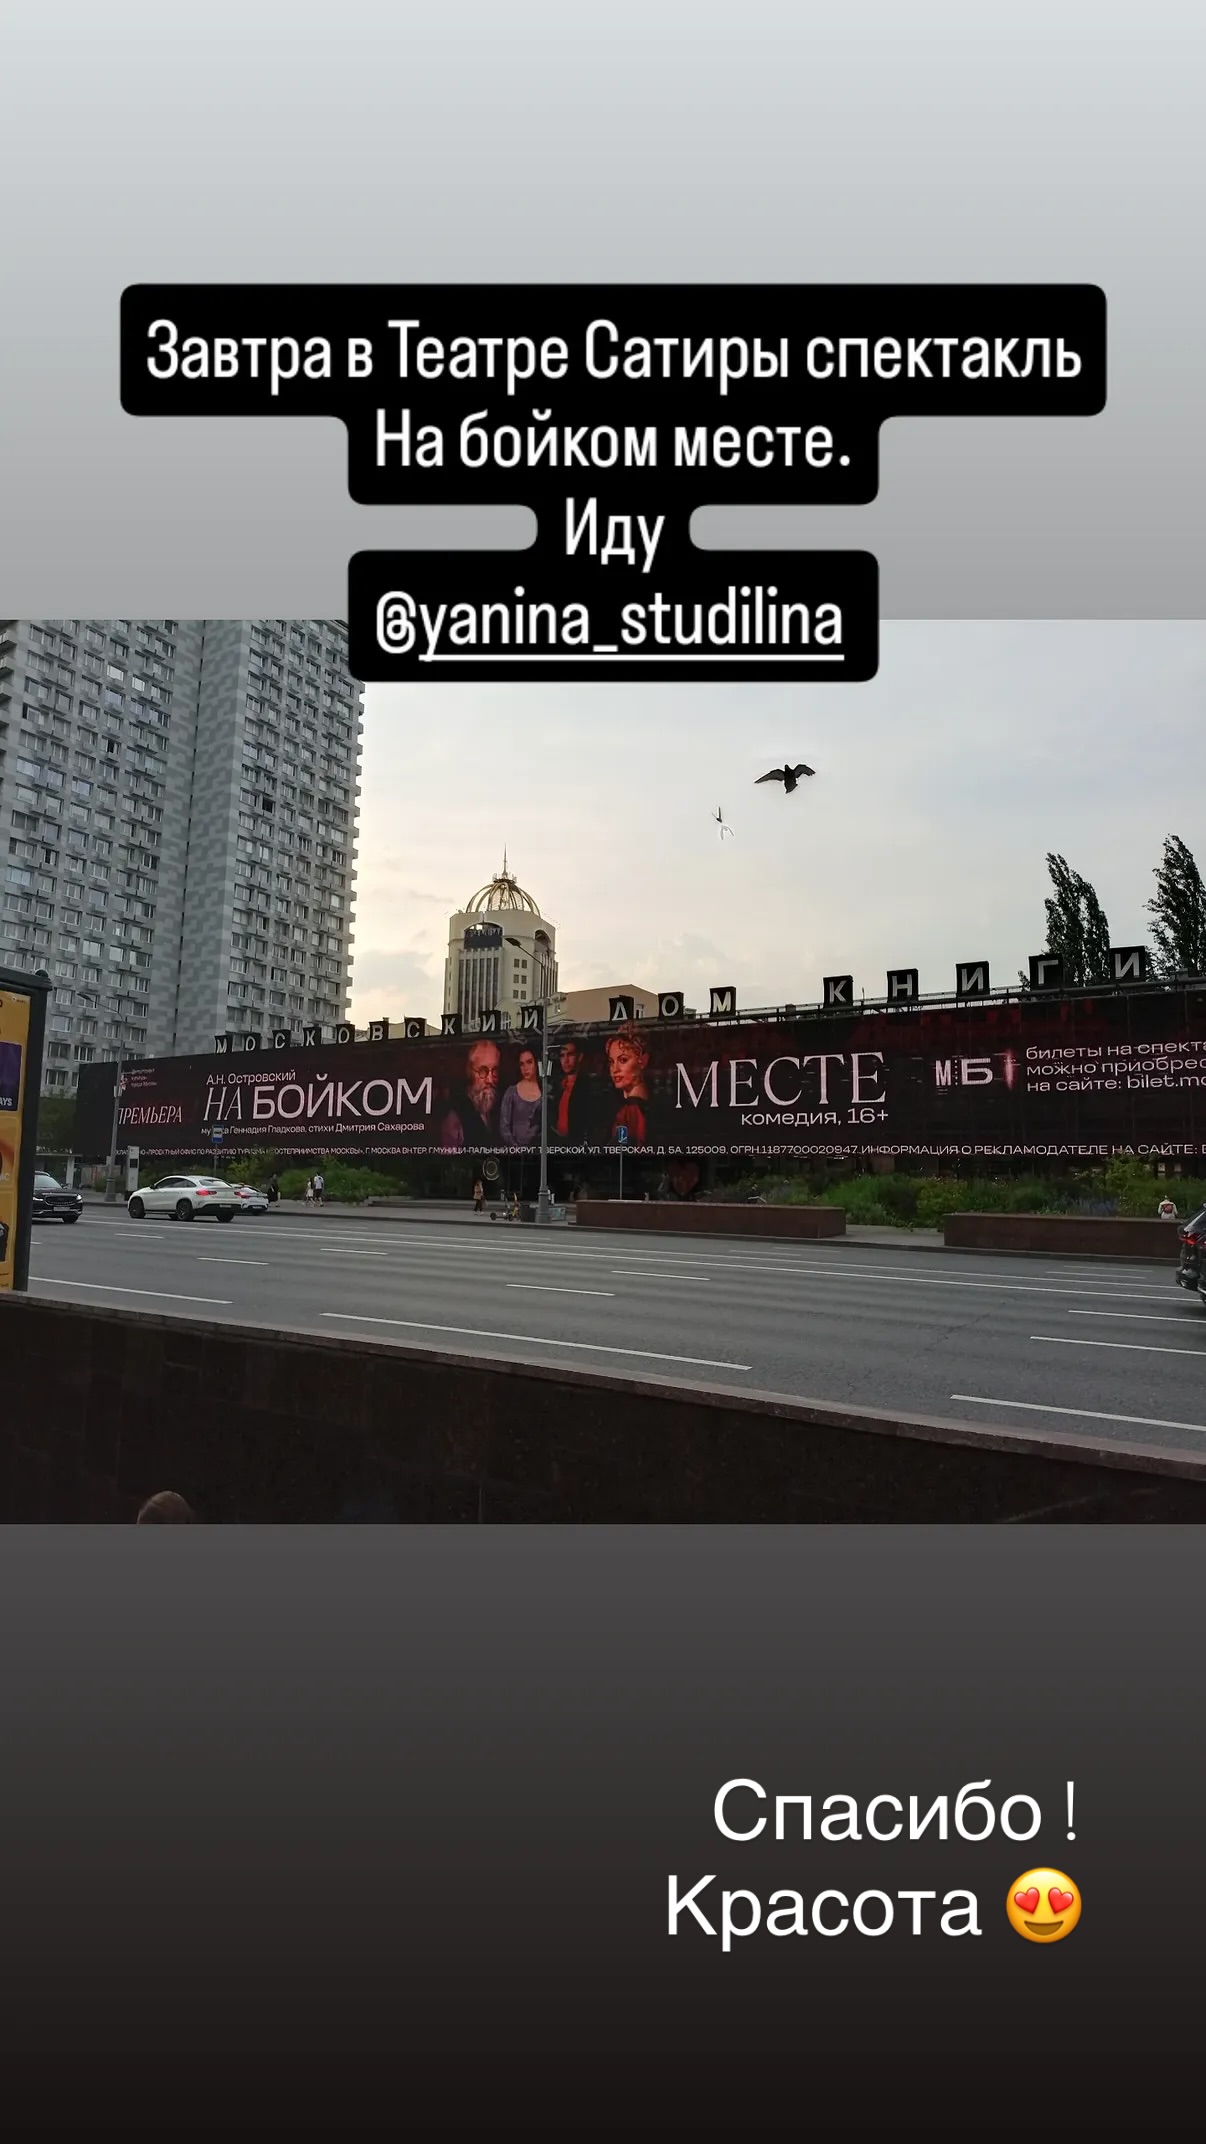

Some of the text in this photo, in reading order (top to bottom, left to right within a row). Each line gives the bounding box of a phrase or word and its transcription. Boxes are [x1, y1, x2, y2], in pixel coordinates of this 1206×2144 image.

[215, 952, 1140, 1054] МОСКОВСКИЙ ДОМ КНИГИ
[1025, 1041, 1206, 1060] билеты на спект
[206, 1069, 296, 1086] А.Н. Островский
[1026, 1062, 1097, 1077] можно
[675, 1051, 886, 1109] МЕСТЕ
[1027, 1080, 1050, 1092] на
[1055, 1076, 1122, 1092] сайте:
[203, 1073, 433, 1121] НА БОЙКОМ
[740, 1107, 889, 1127] комедия, 16+
[308, 1125, 334, 1133] стихи
[335, 1123, 376, 1134] Дмитрия
[377, 1122, 425, 1134] Сахарова
[509, 1146, 536, 1154] ОКРУГ
[861, 1145, 958, 1156] ИНФОРМАЦИЯ
[974, 1145, 1108, 1156] РЕКЛАМОДАТЕЛЕ
[1112, 1145, 1134, 1154] НА
